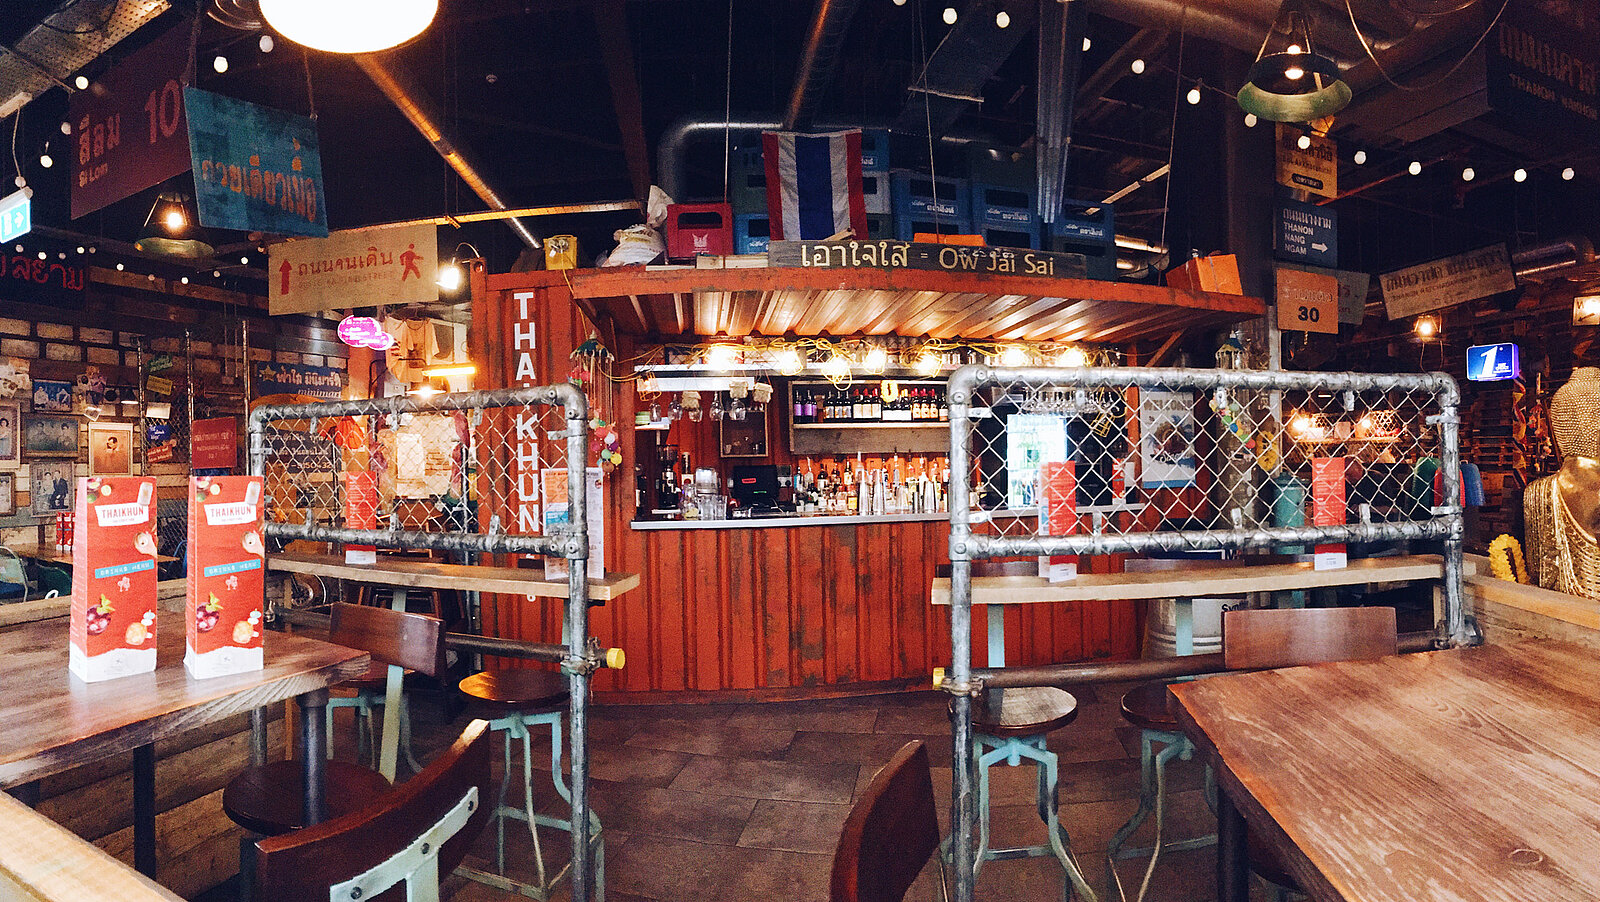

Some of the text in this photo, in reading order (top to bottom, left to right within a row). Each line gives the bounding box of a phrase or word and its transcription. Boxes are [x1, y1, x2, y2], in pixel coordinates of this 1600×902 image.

[145, 80, 182, 144] 10
[1283, 221, 1314, 236] THANON
[1284, 233, 1306, 245] NANG
[1284, 243, 1307, 255] NGAM
[1024, 252, 1055, 276] Sai
[1298, 305, 1320, 323] 30
[102, 506, 144, 519] THAIKHUN
[211, 506, 252, 518] THAIKHUN
